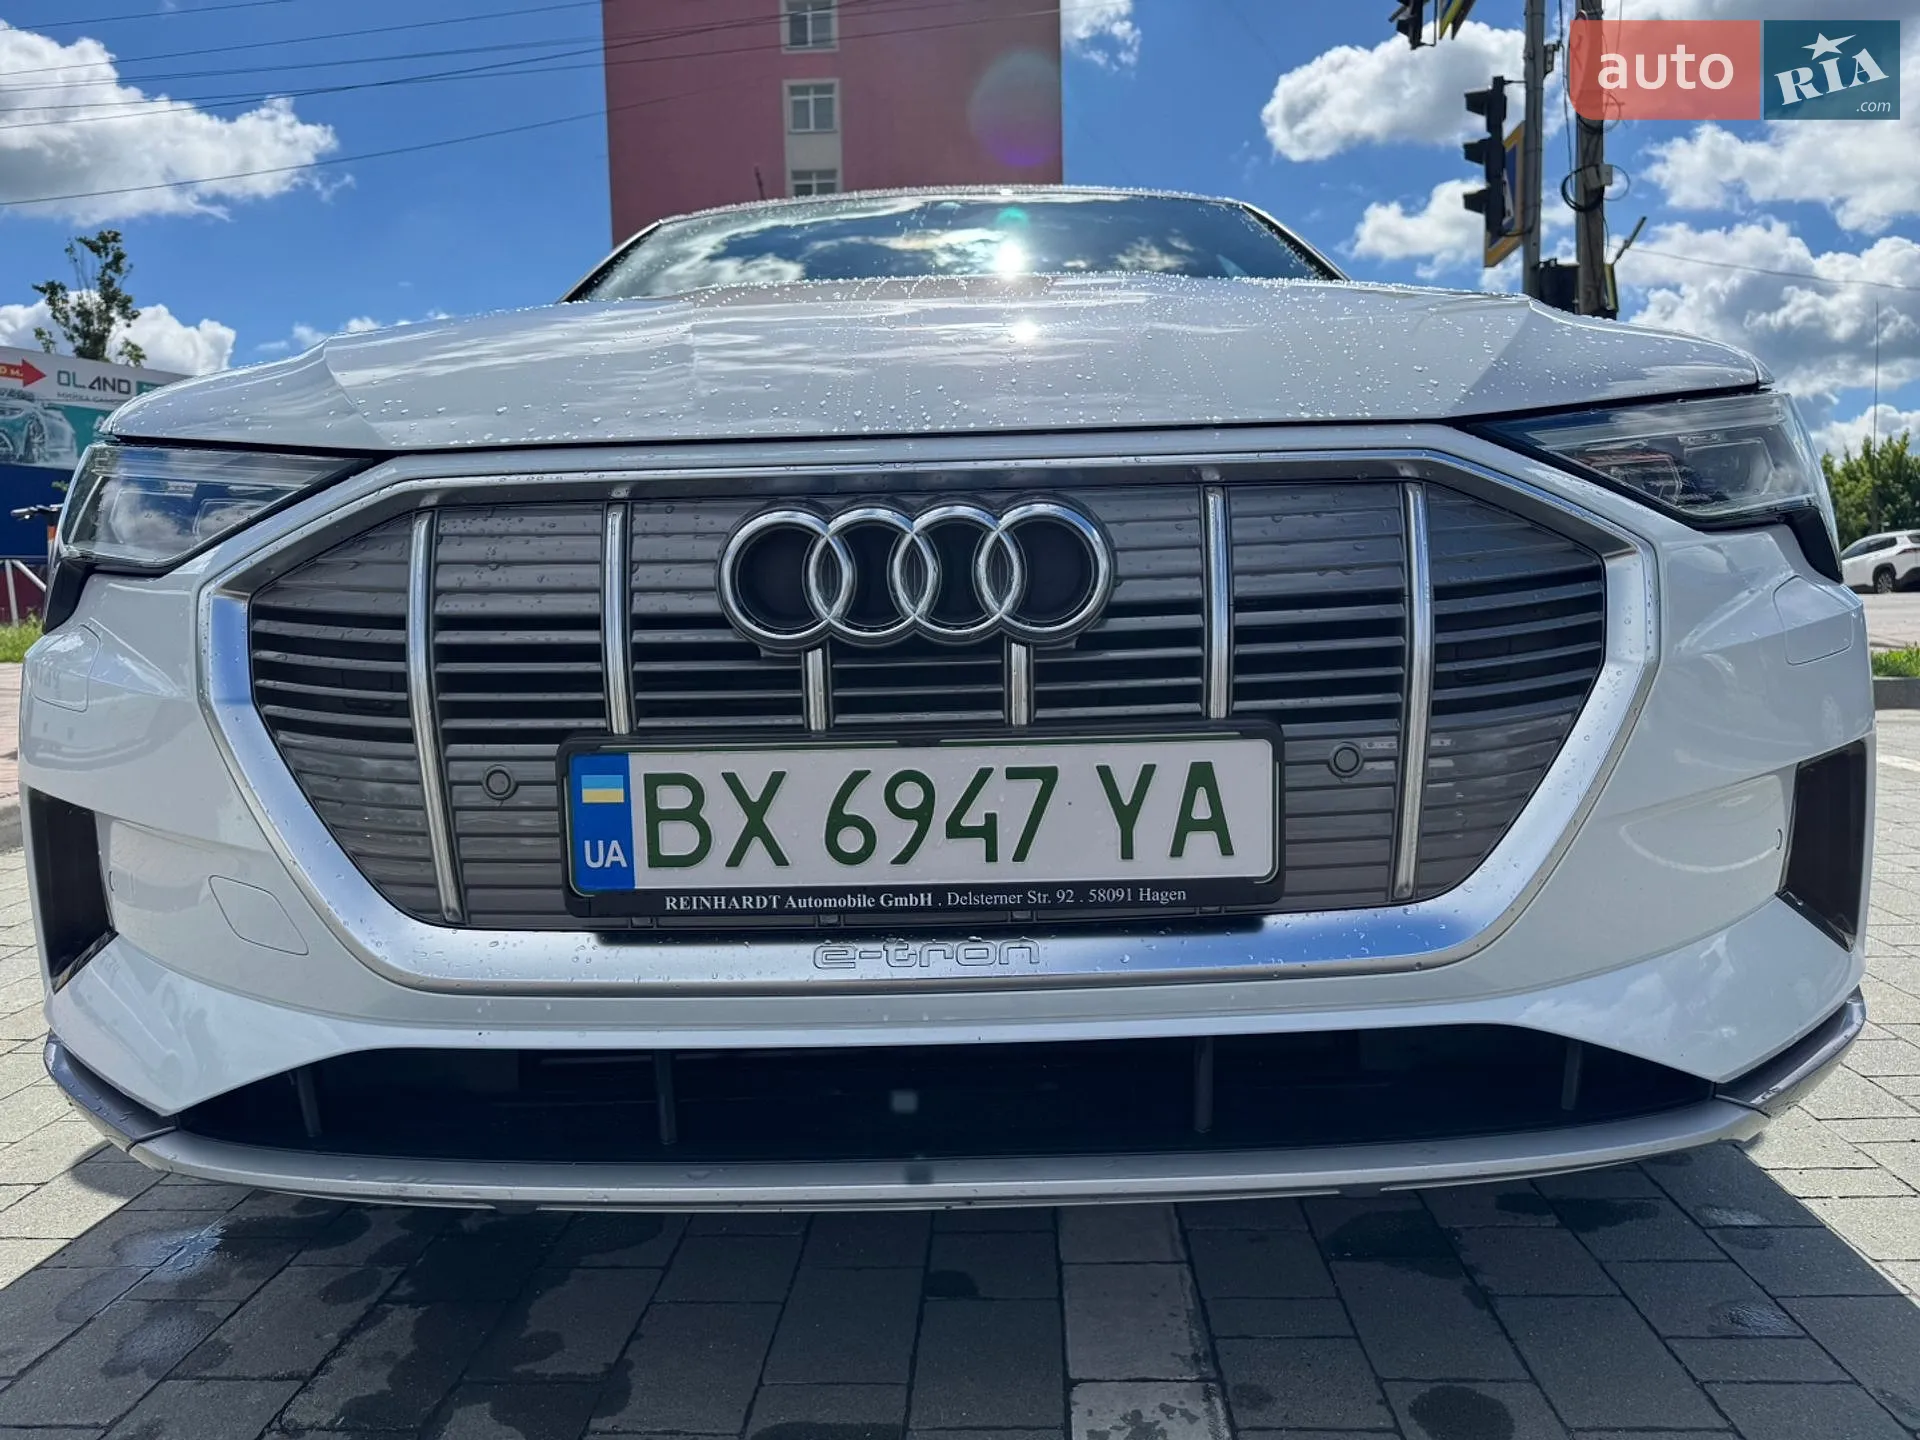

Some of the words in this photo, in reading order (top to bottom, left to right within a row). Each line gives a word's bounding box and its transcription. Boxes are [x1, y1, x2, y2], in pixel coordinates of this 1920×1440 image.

[57, 369, 131, 395] OLAND
[643, 770, 790, 869] BX
[824, 766, 1059, 867] 6947
[1095, 761, 1235, 861] YA
[584, 840, 628, 869] UA
[664, 895, 781, 911] REINHARDT
[784, 893, 876, 909] Automobile
[947, 891, 1023, 906] Delsterner
[1027, 890, 1052, 905] Str.
[1088, 887, 1132, 903] 58091
[1138, 887, 1187, 905] Hagen
[813, 938, 1040, 970] e-tron
